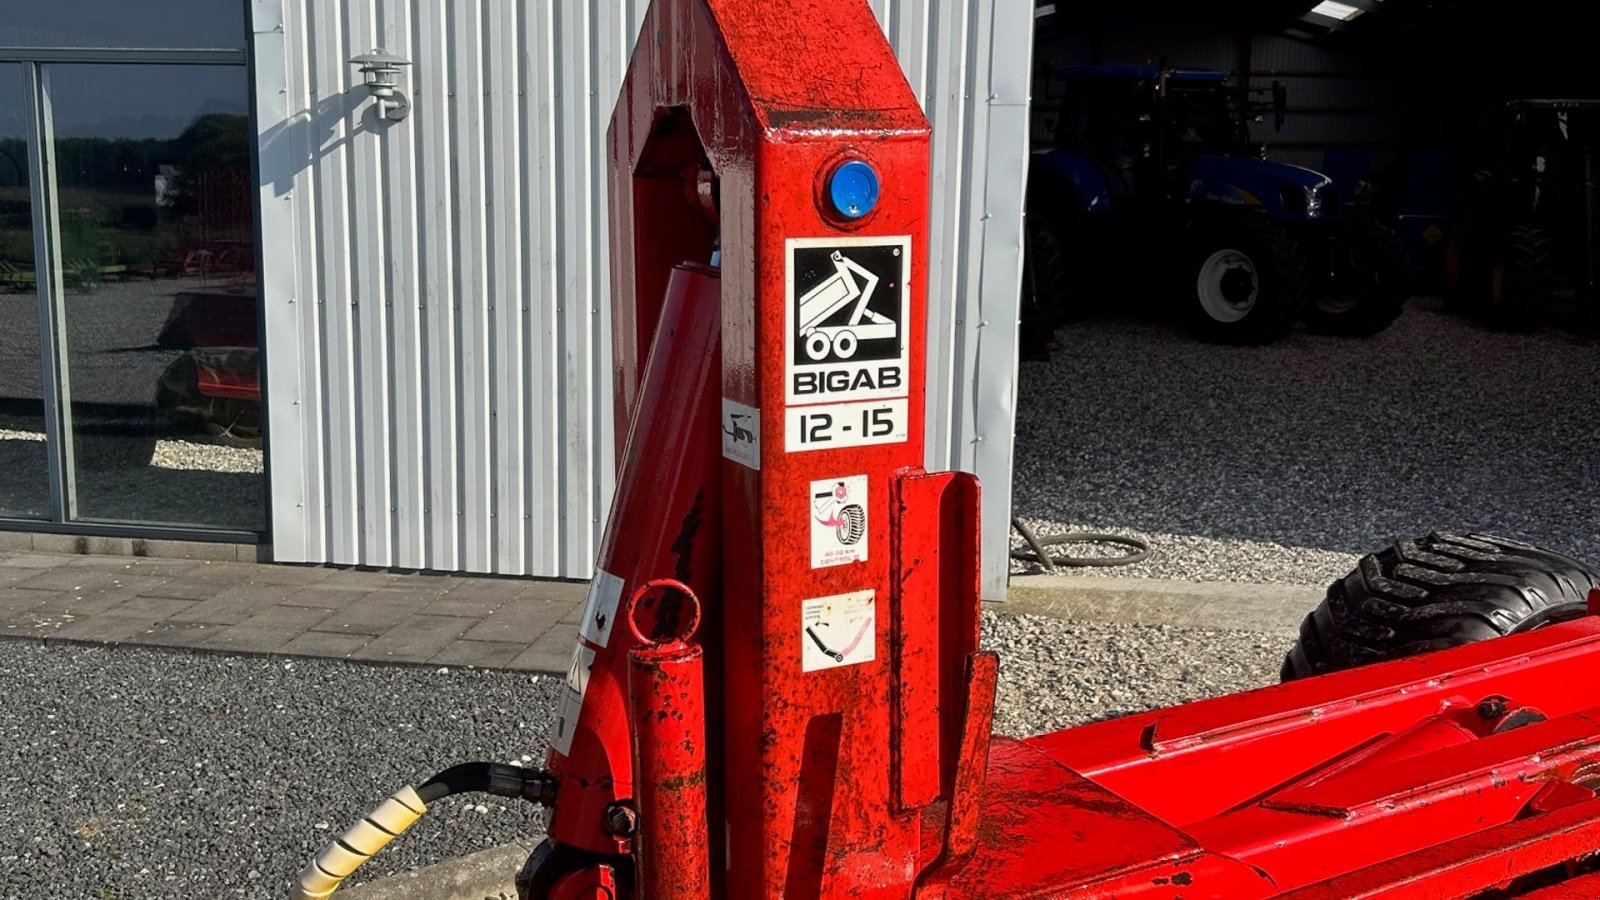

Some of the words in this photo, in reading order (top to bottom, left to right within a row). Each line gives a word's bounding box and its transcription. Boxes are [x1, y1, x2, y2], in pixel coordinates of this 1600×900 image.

[793, 366, 902, 396] BIGAB
[800, 413, 833, 444] 12
[862, 407, 894, 438] 15
[819, 555, 852, 565] CONTROL
